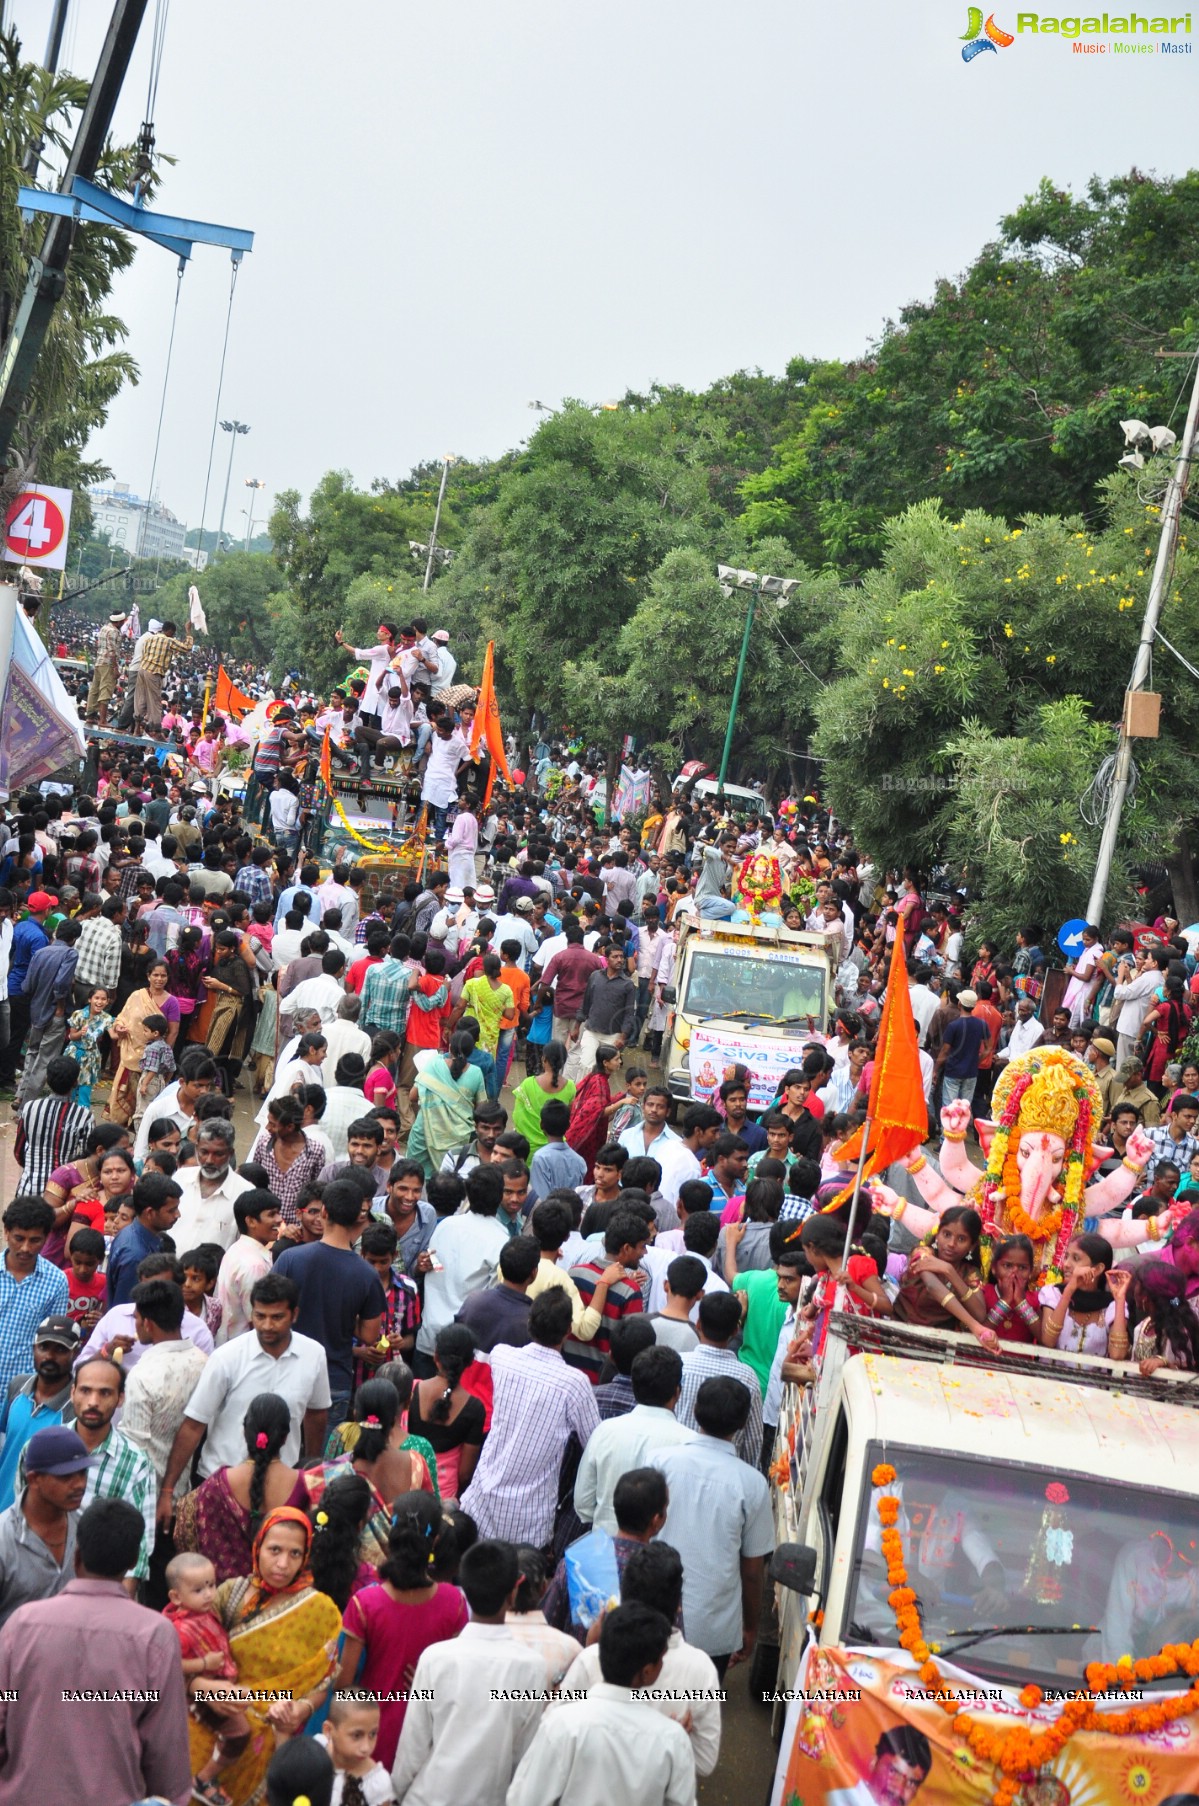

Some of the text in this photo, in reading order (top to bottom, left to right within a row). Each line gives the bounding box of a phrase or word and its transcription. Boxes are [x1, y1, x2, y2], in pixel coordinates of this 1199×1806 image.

[8, 498, 51, 549] 4
[723, 947, 800, 963] GOODS CARRIER
[722, 1047, 768, 1062] Siva
